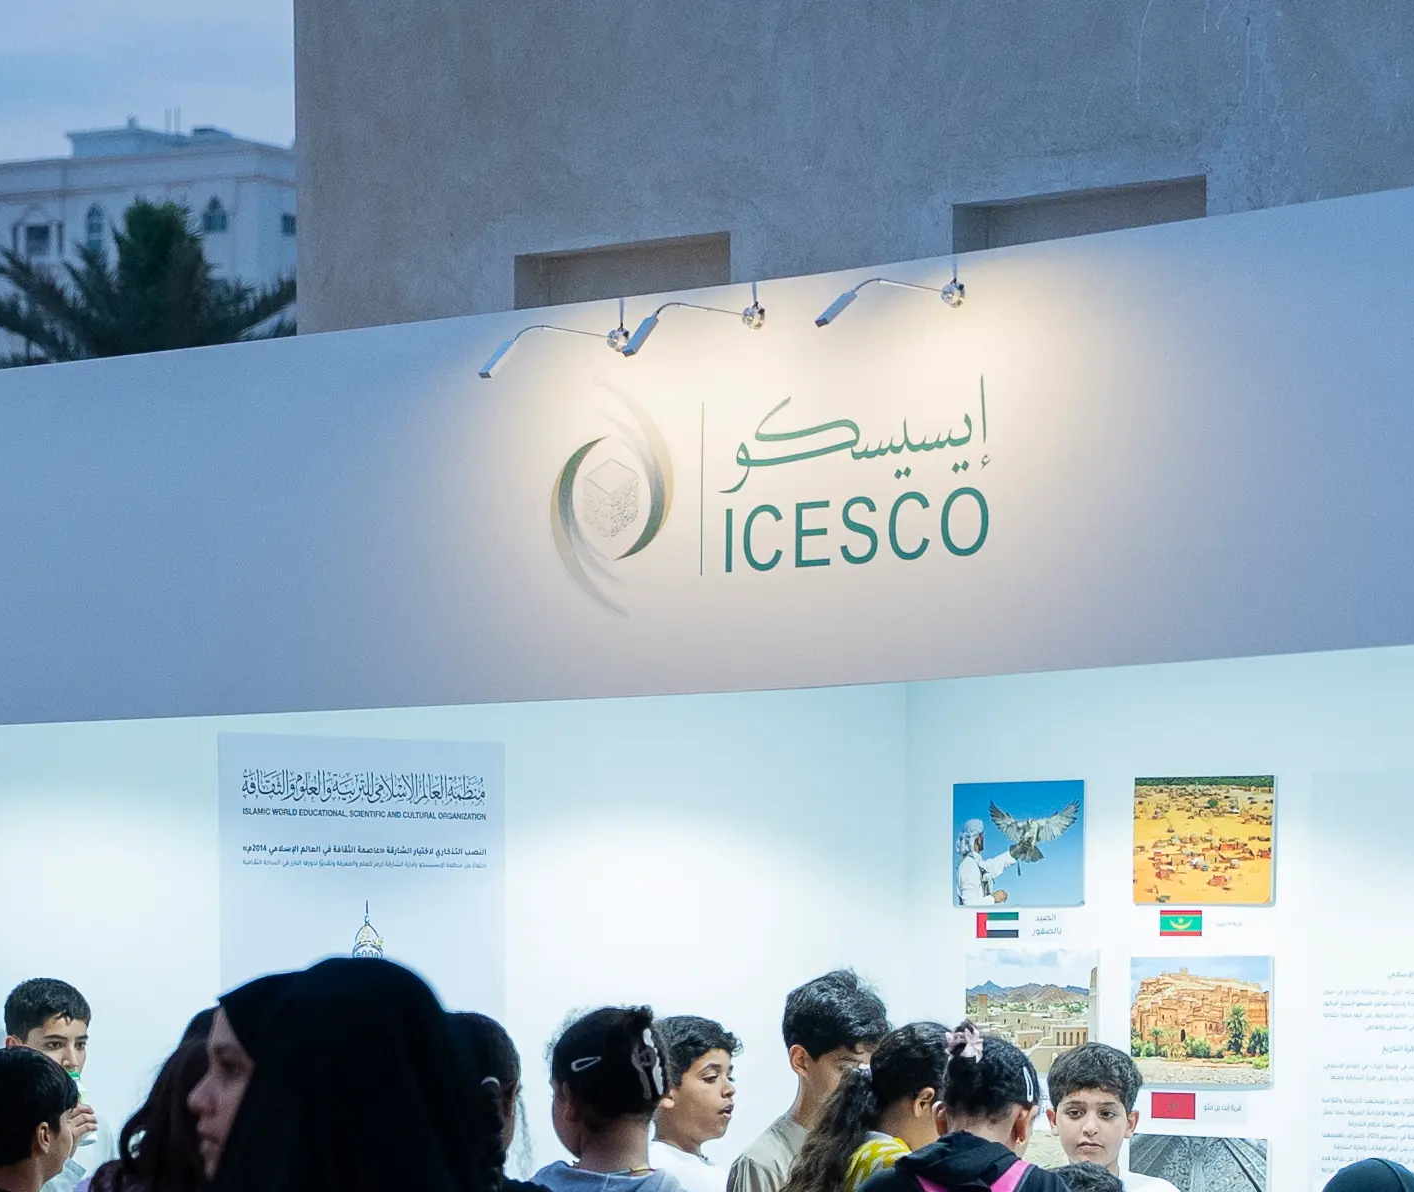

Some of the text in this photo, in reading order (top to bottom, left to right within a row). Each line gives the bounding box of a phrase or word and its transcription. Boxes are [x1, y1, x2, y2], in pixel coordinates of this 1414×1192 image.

[718, 372, 991, 493] إيسيسكو
[724, 486, 989, 573] ICESCO
[242, 808, 271, 816] ISLAMIC
[272, 808, 298, 816] WORLD
[349, 810, 386, 819] SCIENTIFIC
[387, 811, 401, 819] AND
[403, 811, 437, 820] CULTURAL
[438, 812, 487, 821] ORGANIZATION
